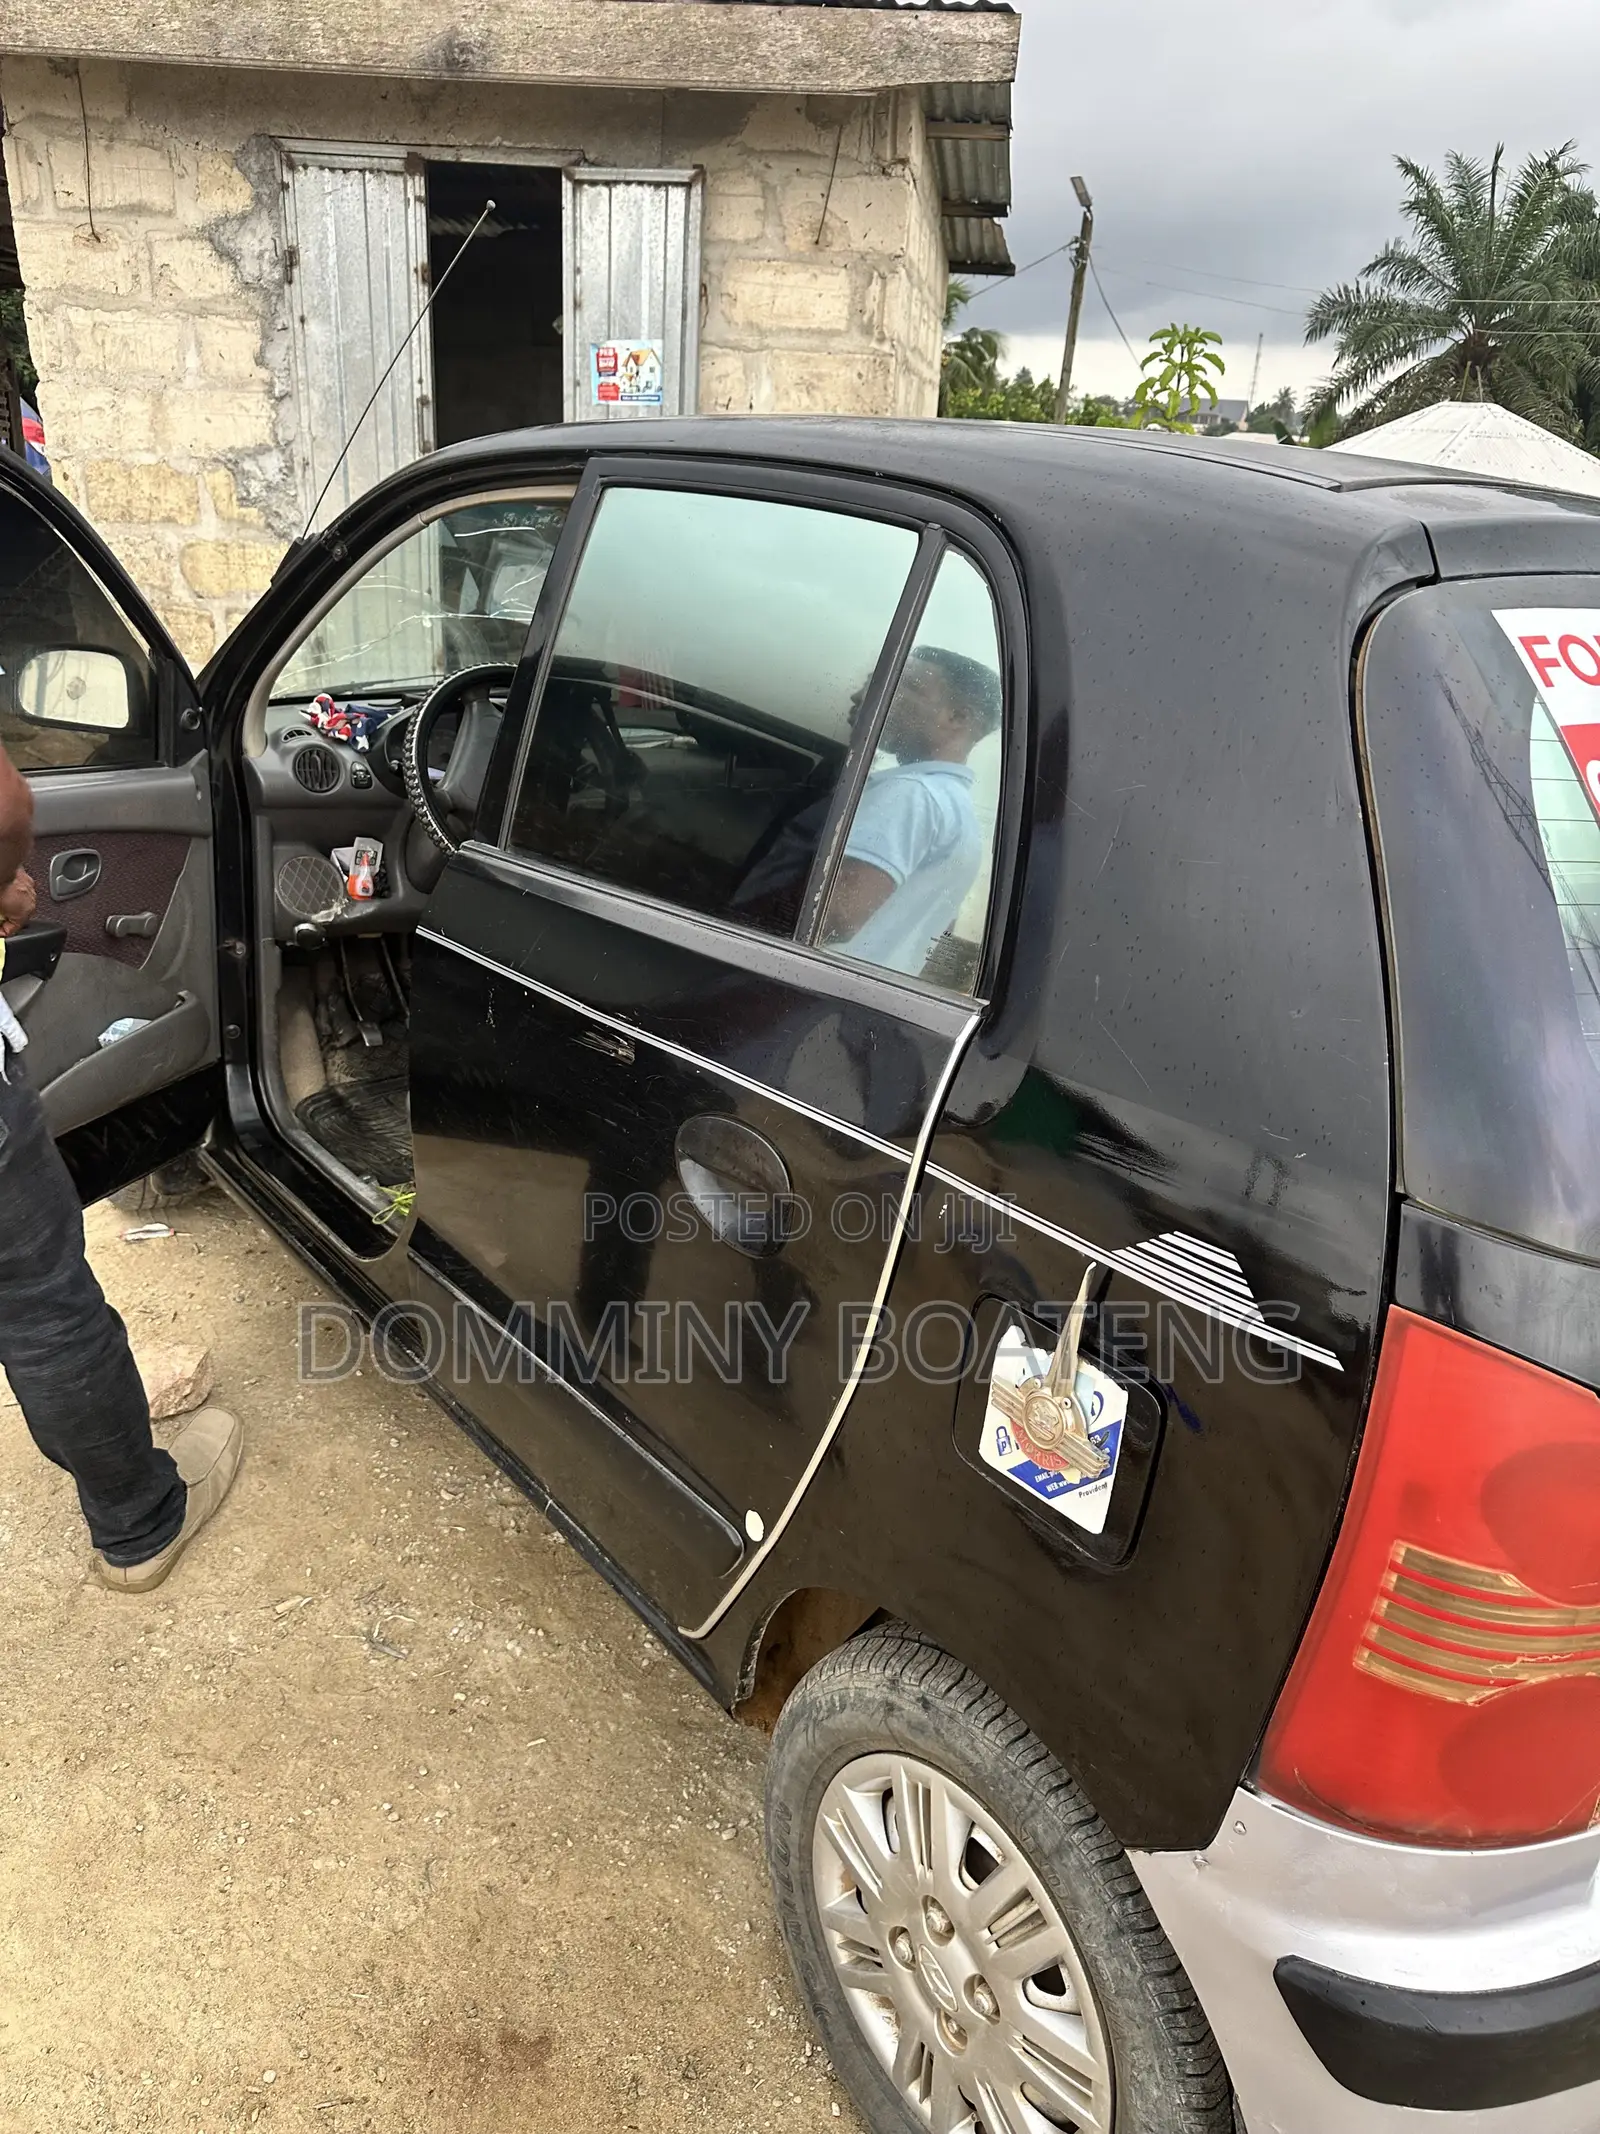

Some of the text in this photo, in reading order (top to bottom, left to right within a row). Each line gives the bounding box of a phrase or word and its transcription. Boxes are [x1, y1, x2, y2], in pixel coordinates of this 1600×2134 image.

[1517, 634, 1600, 687] FO
[1014, 1429, 1063, 1468] MORRIS
[1078, 1481, 1108, 1499] Provident
